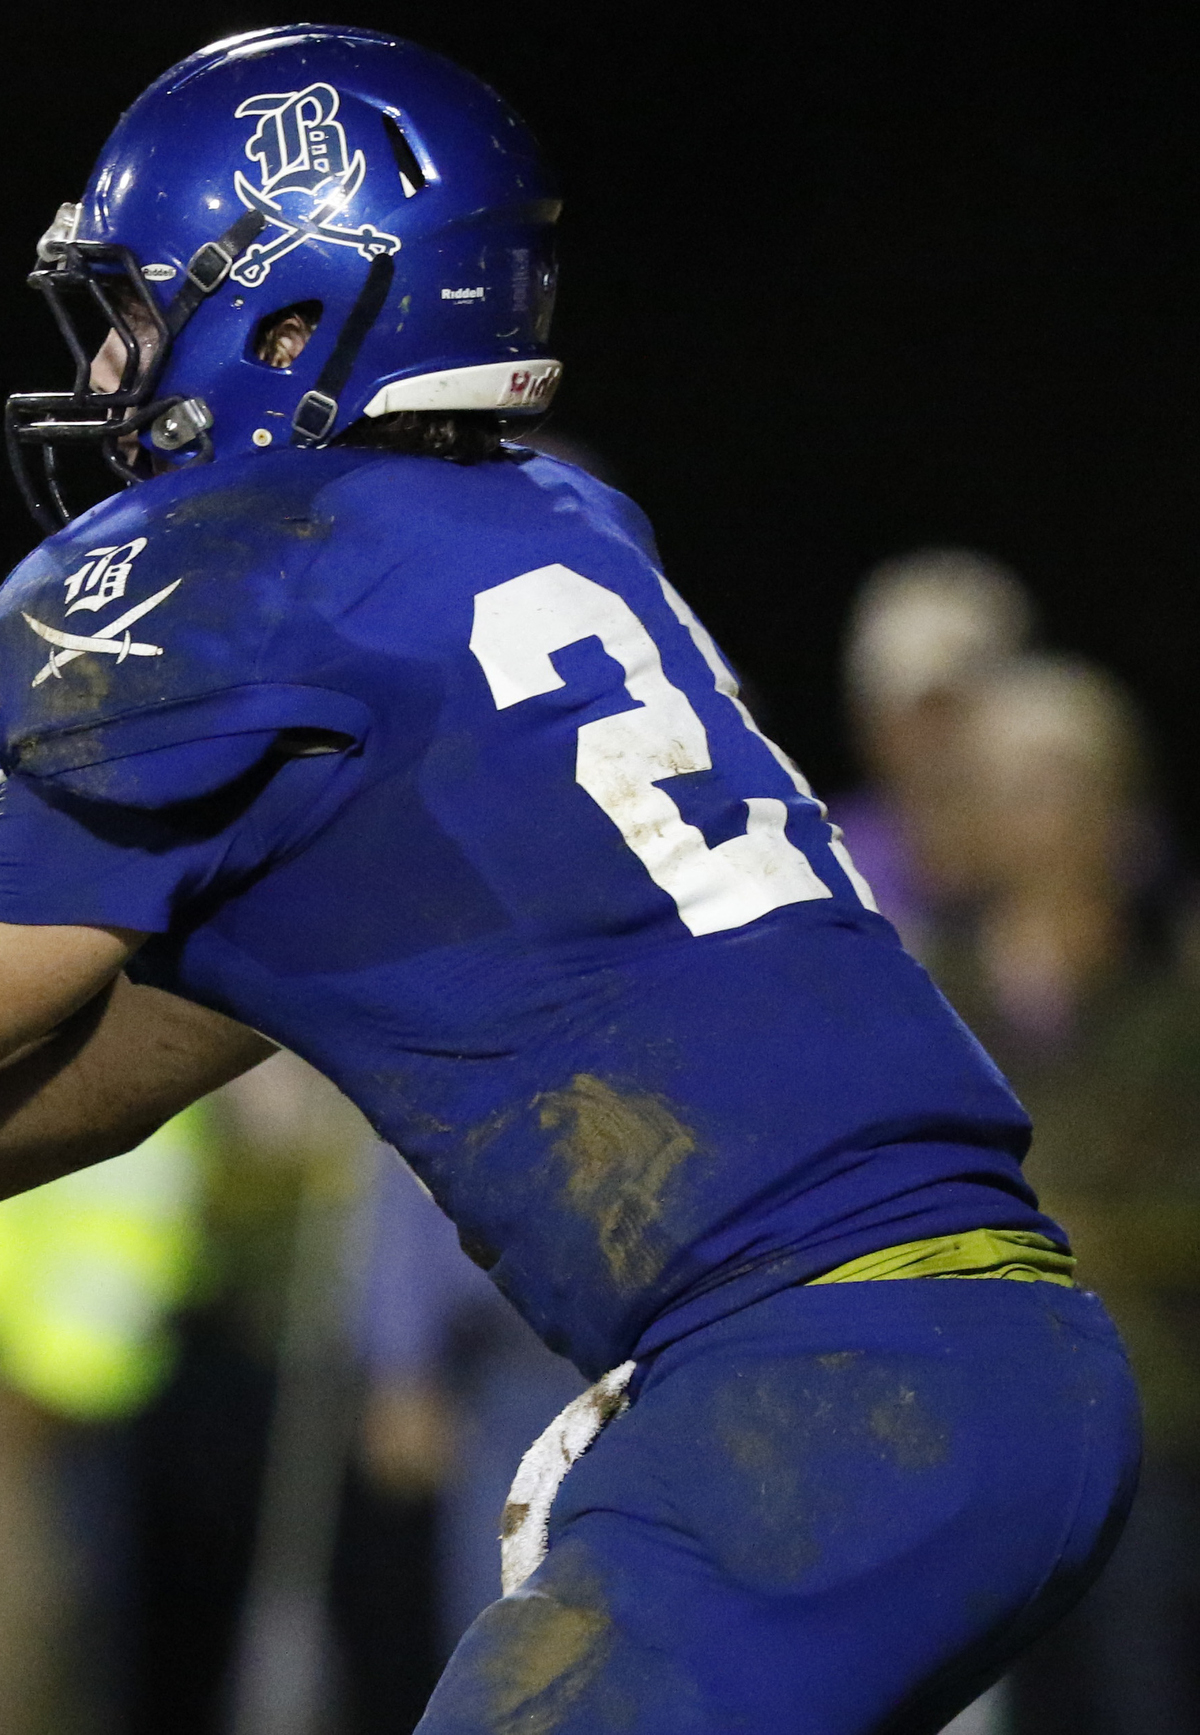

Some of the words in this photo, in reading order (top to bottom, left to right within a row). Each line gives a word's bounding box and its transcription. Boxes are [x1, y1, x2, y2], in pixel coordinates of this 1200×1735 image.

[234, 82, 349, 200] B
[441, 287, 484, 300] Riddell
[64, 537, 147, 618] B
[469, 563, 880, 938] 2
